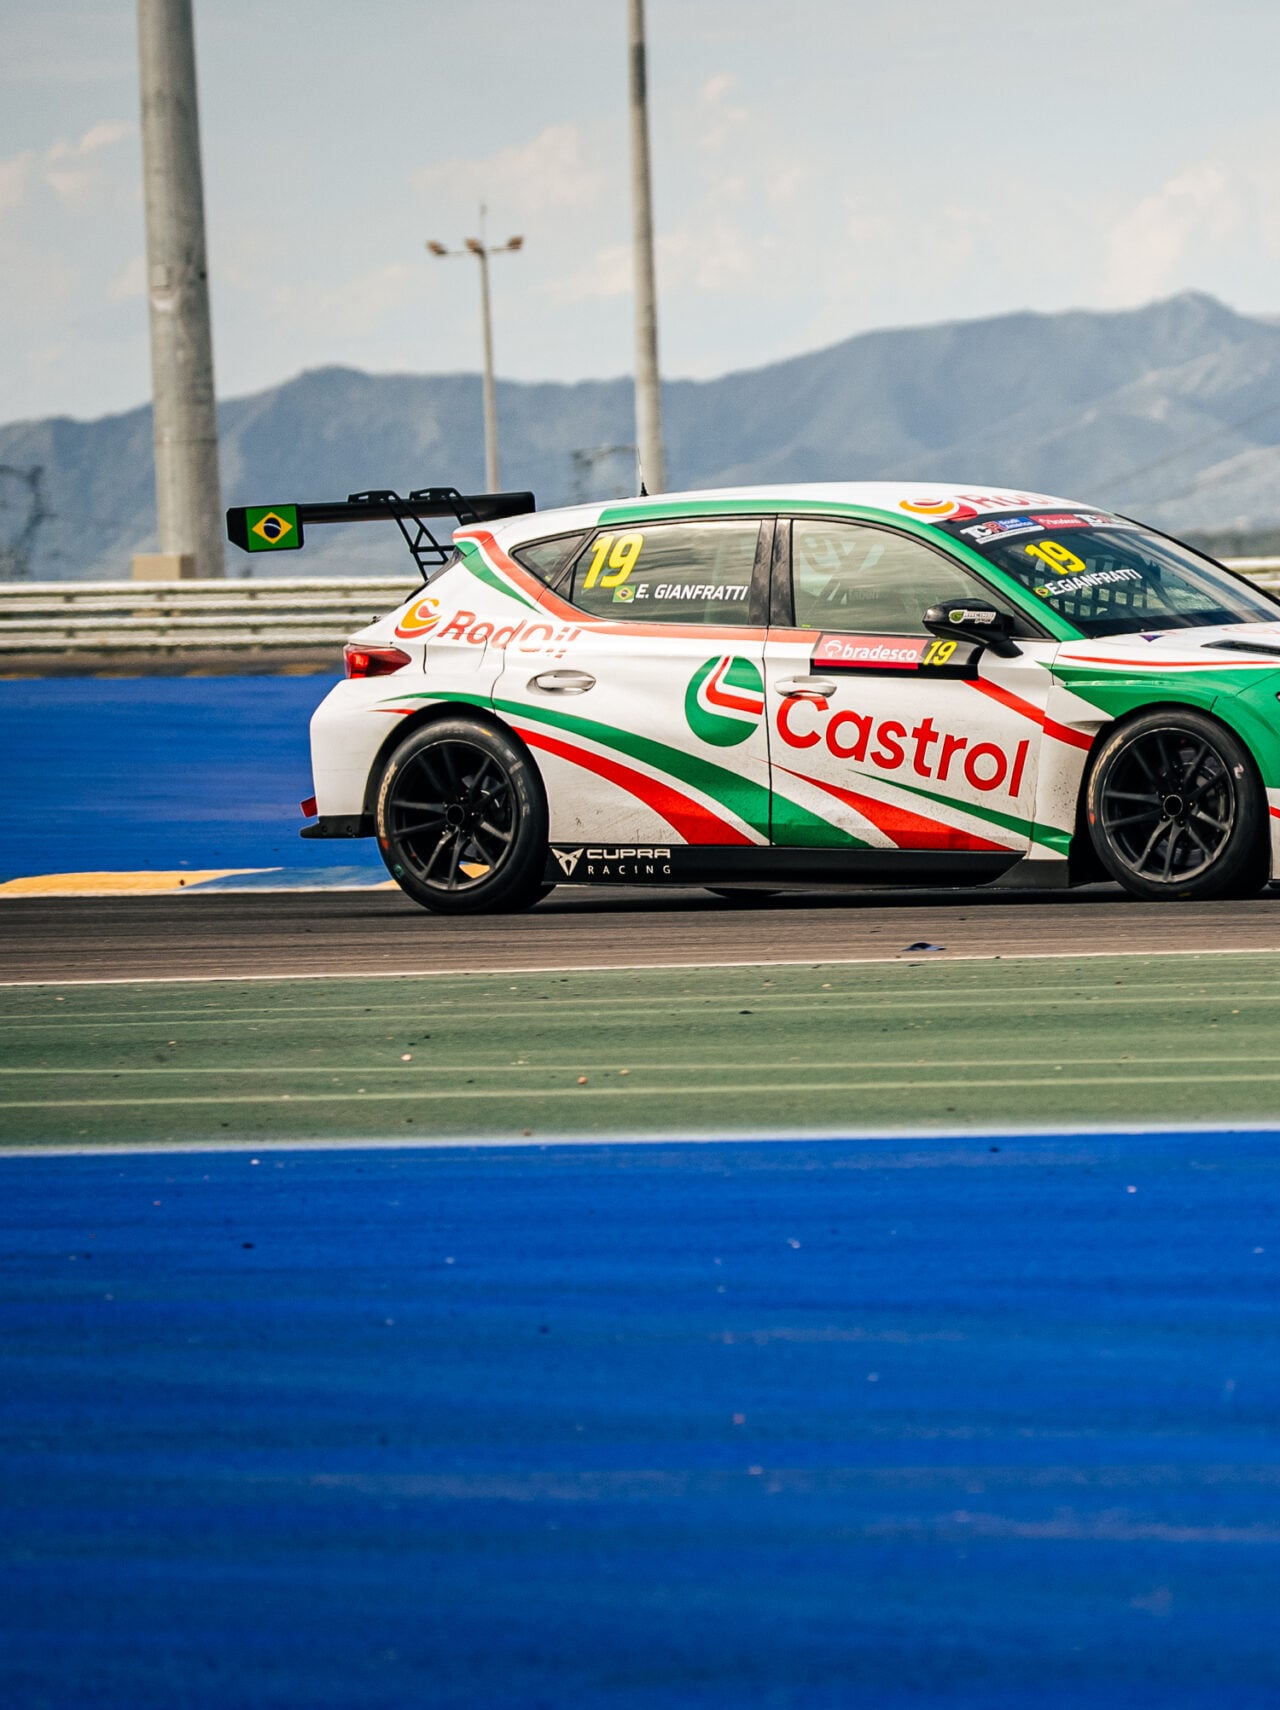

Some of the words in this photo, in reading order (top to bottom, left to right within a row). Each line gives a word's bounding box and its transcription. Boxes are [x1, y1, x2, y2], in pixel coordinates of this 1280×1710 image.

[583, 533, 644, 589] 19
[1025, 541, 1086, 575] 19
[636, 584, 650, 599] E.
[654, 584, 748, 600] GIANFRATTI
[842, 644, 917, 661] bradesco
[923, 640, 958, 666] 19
[776, 694, 1030, 798] Castrol
[586, 848, 671, 859] CUPRA
[587, 865, 671, 875] RACING
